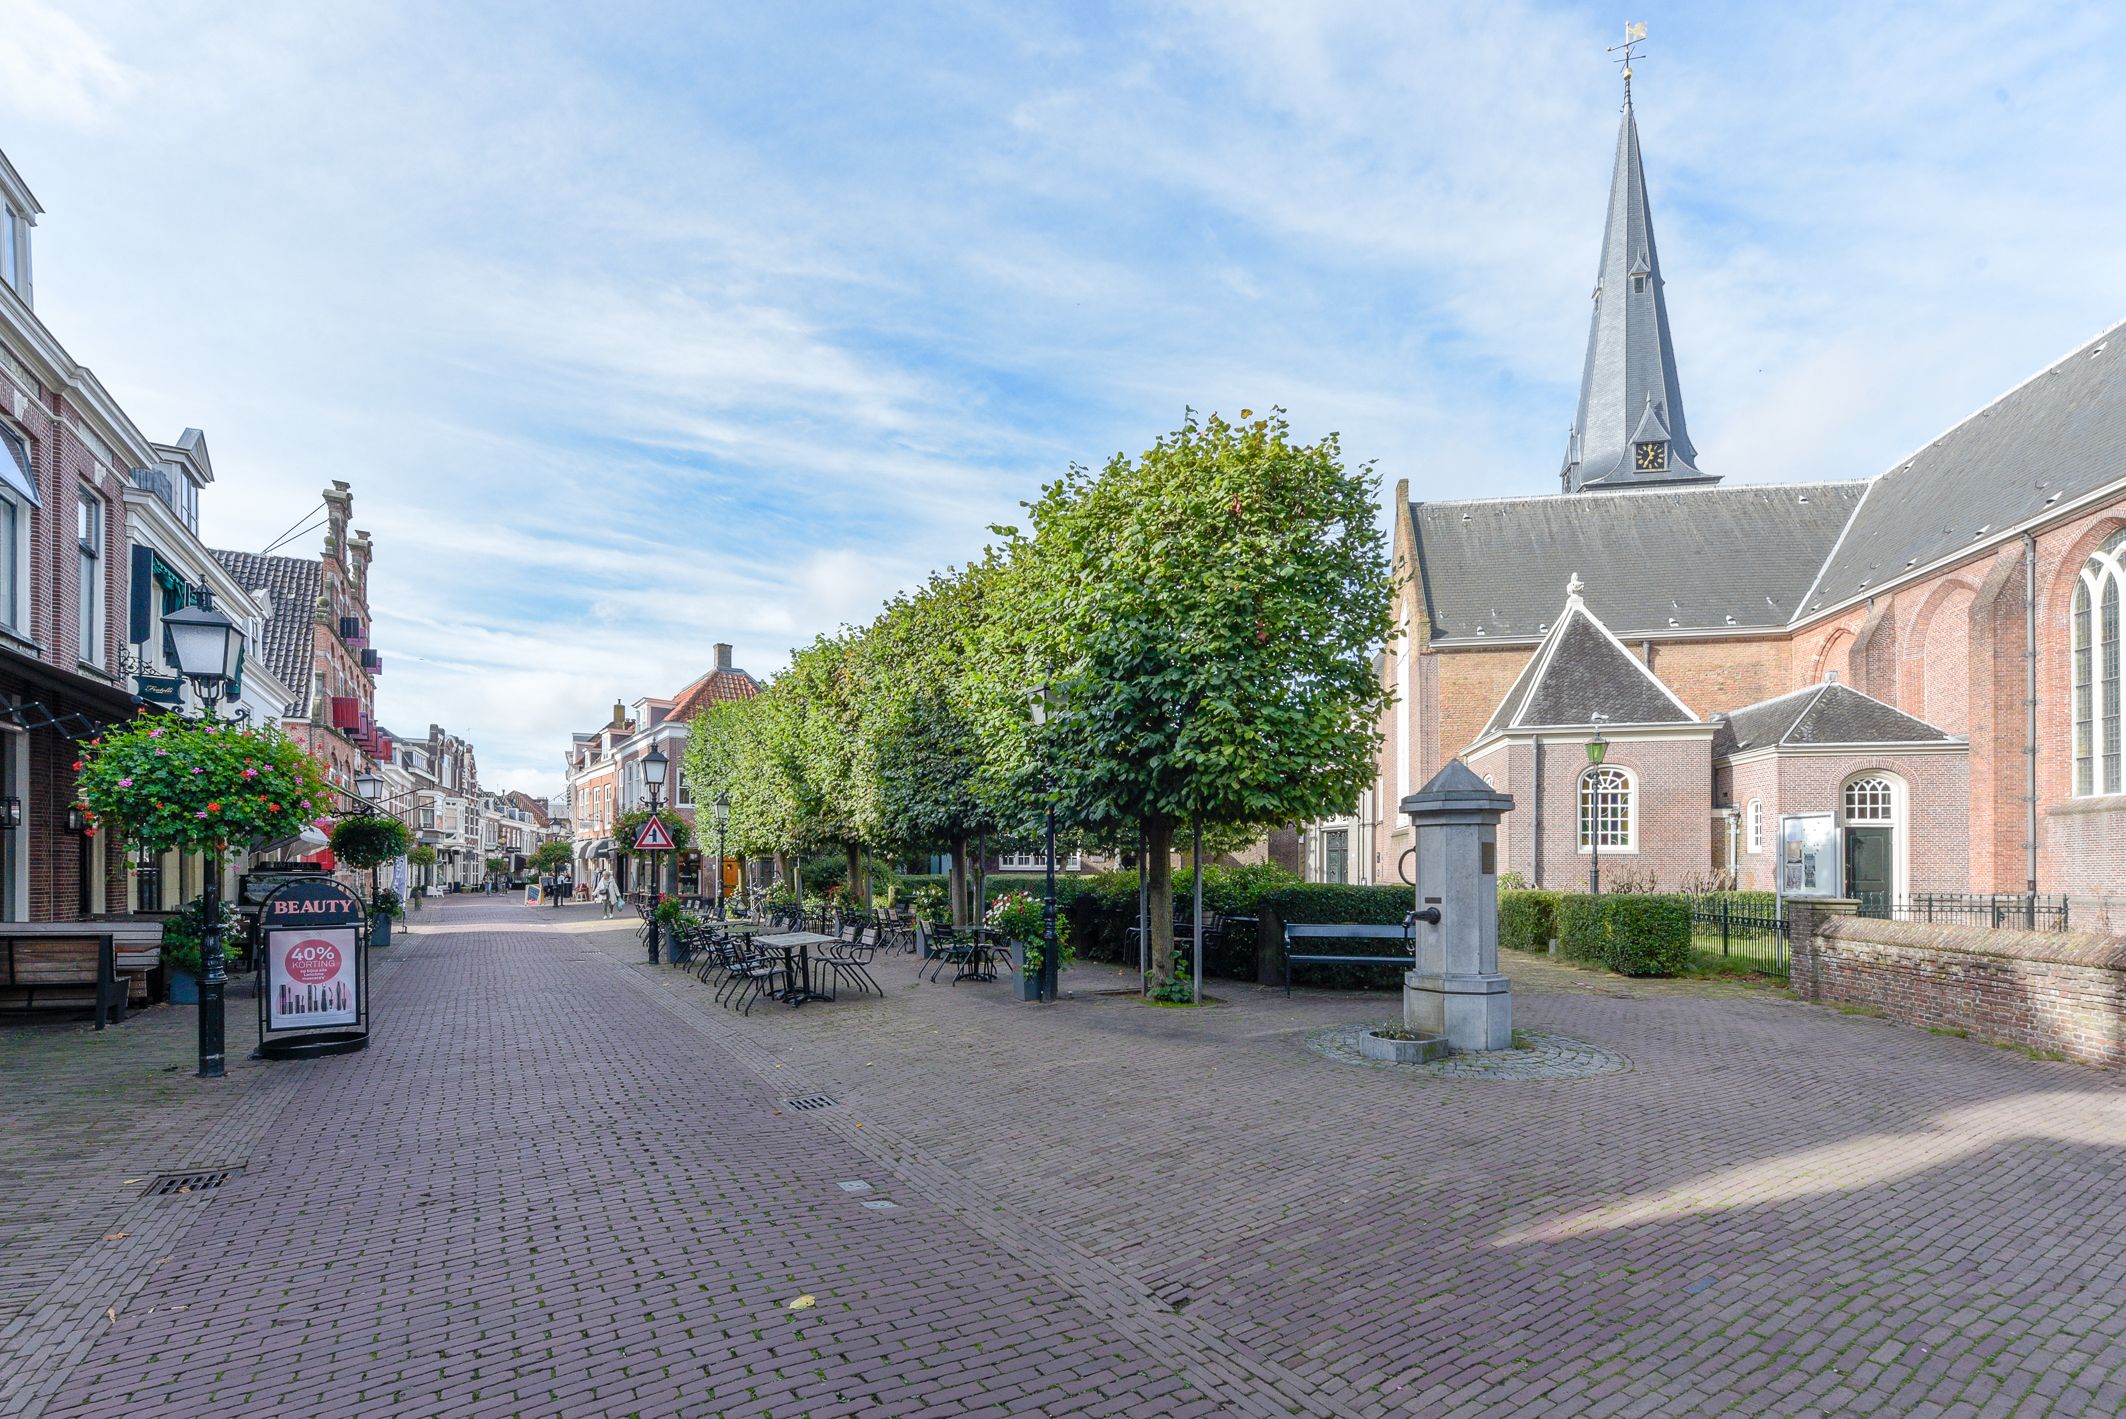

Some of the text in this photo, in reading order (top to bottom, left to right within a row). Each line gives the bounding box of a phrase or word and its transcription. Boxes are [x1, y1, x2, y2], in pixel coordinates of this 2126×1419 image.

[274, 900, 353, 914] BEAUTY
[291, 946, 335, 961] 40%
[292, 960, 336, 969] KORTING
